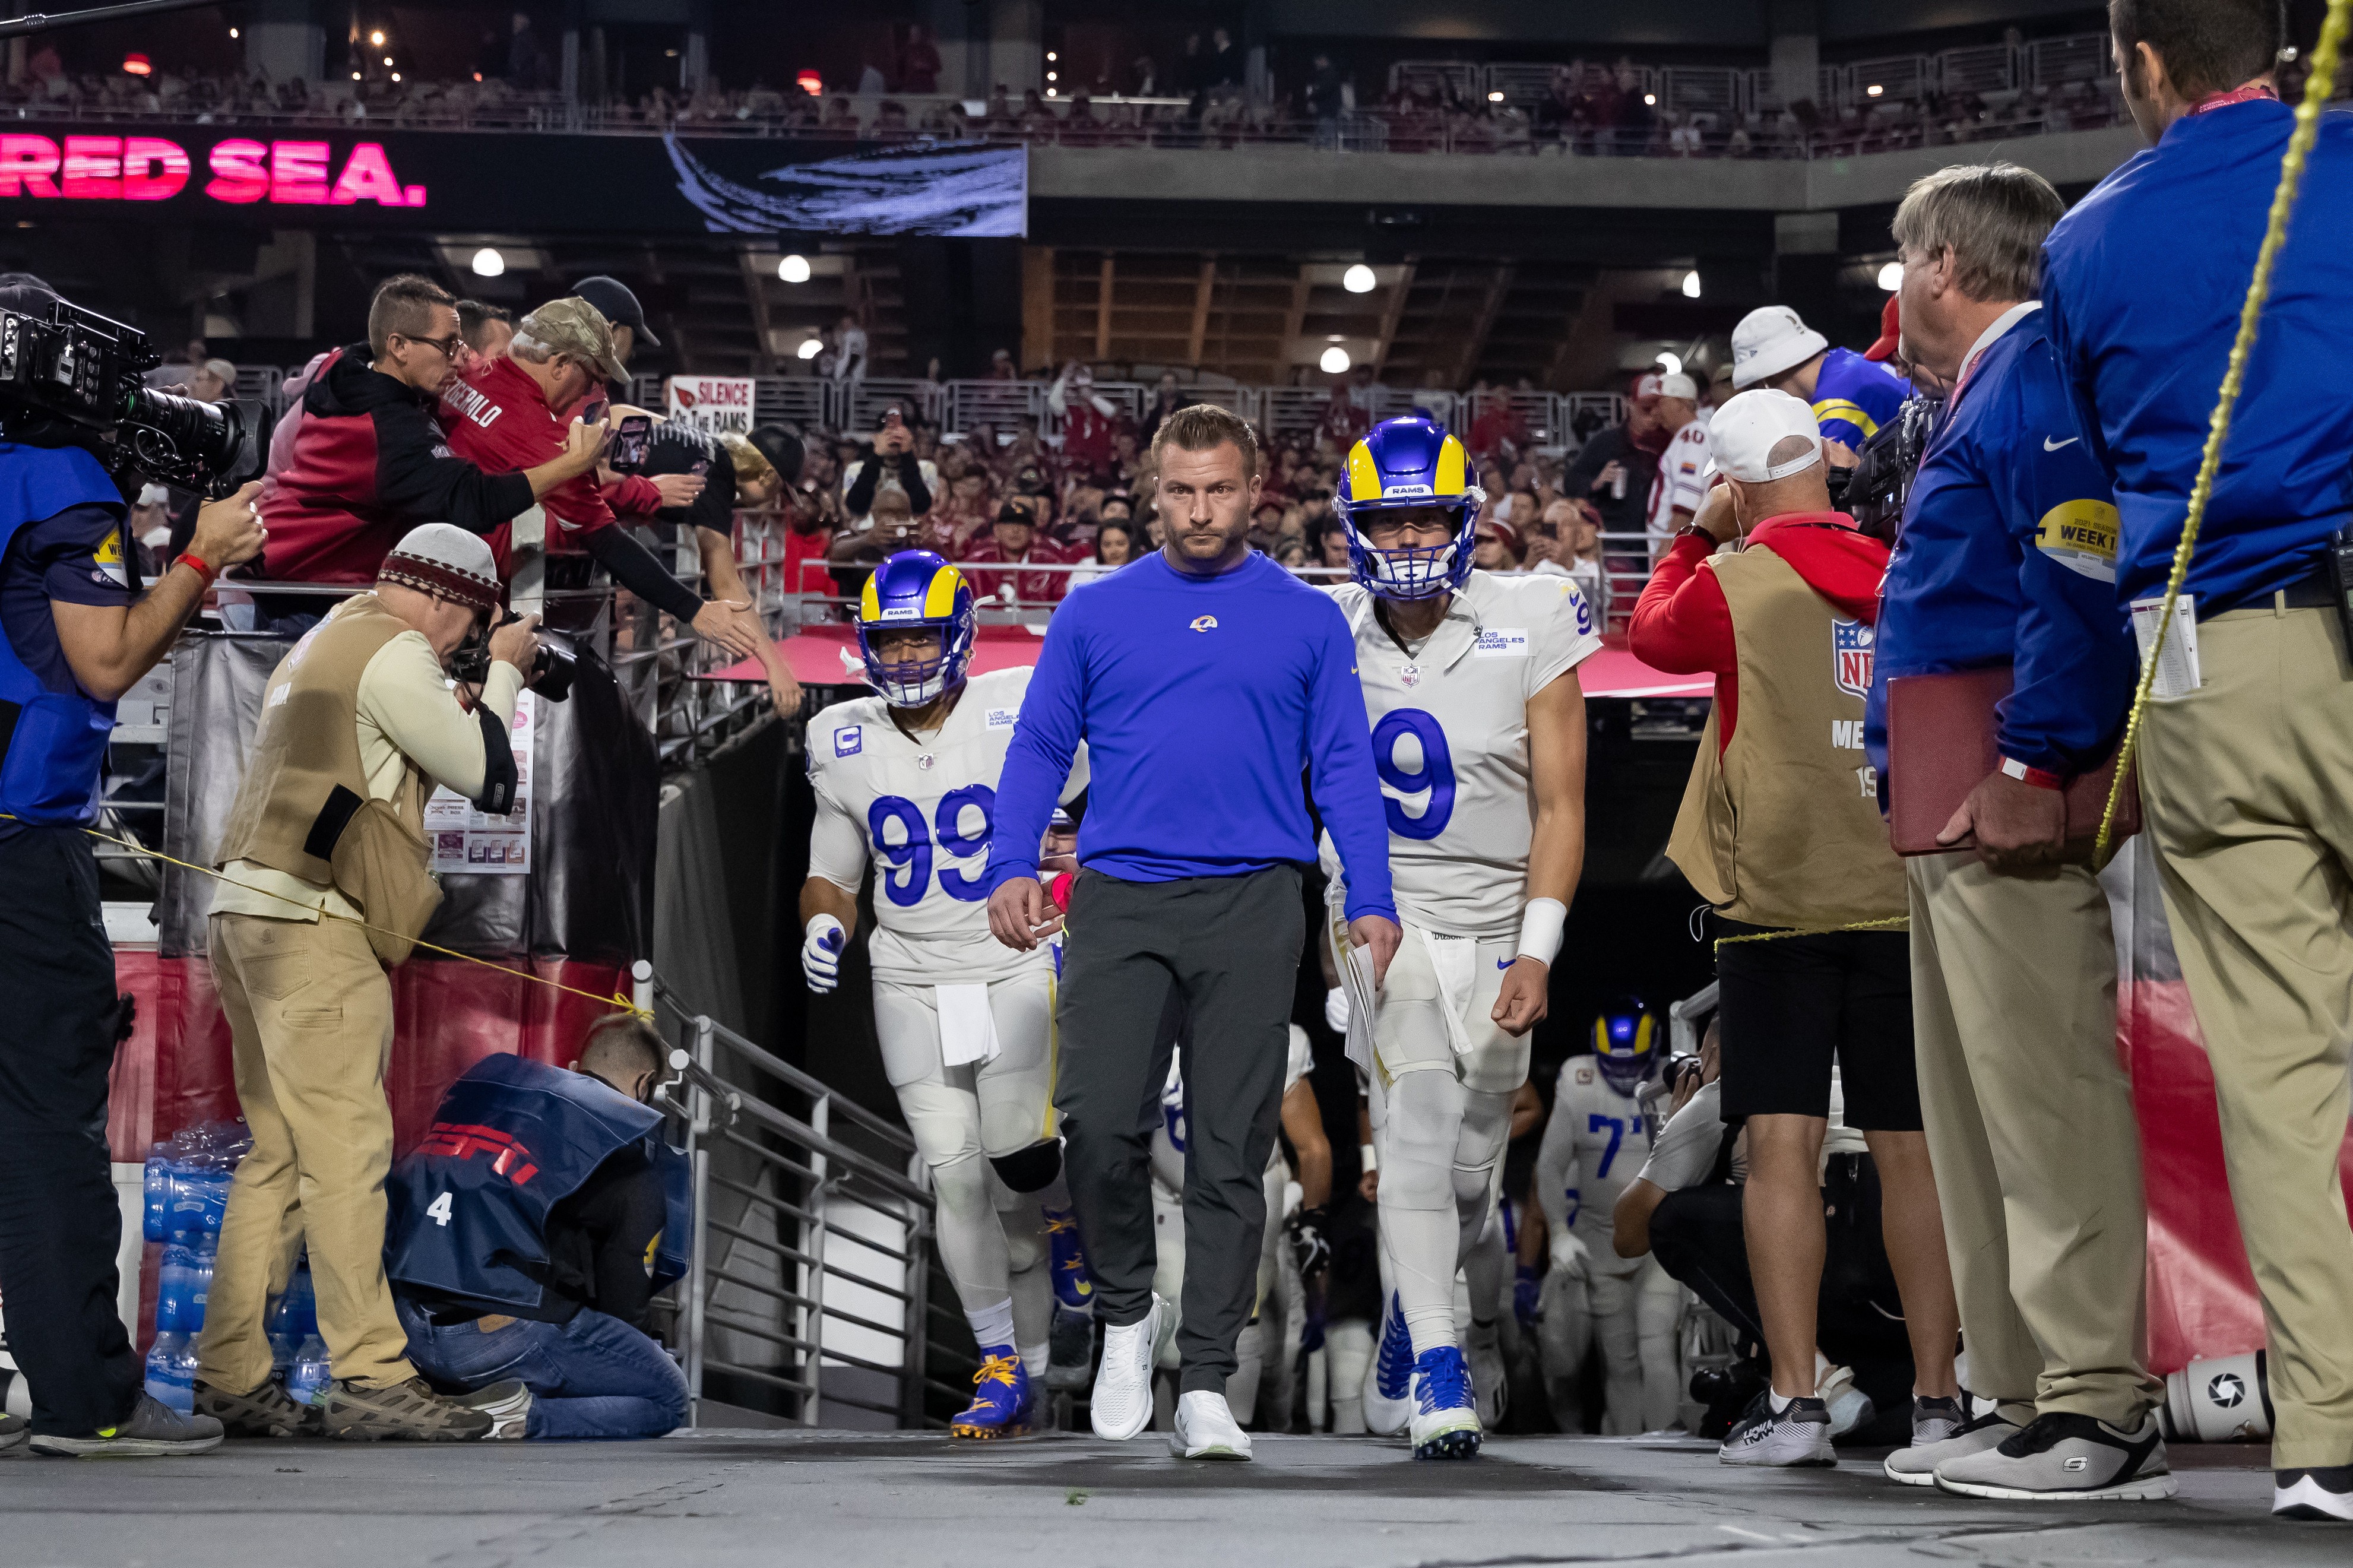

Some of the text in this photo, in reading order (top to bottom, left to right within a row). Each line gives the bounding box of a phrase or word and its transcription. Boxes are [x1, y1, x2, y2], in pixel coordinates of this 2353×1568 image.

[2199, 100, 2235, 113] CARDINALS
[0, 133, 426, 207] RED SEA.
[699, 382, 748, 405] SILENCE
[714, 411, 746, 433] RAMS
[1680, 430, 1704, 444] 40
[2060, 525, 2108, 549] WEEK
[1576, 601, 1592, 636] 9
[1402, 674, 1417, 683] NFL
[835, 727, 860, 750] C
[1371, 708, 1456, 841] 9
[867, 784, 996, 907] 99
[426, 1191, 453, 1227] 4
